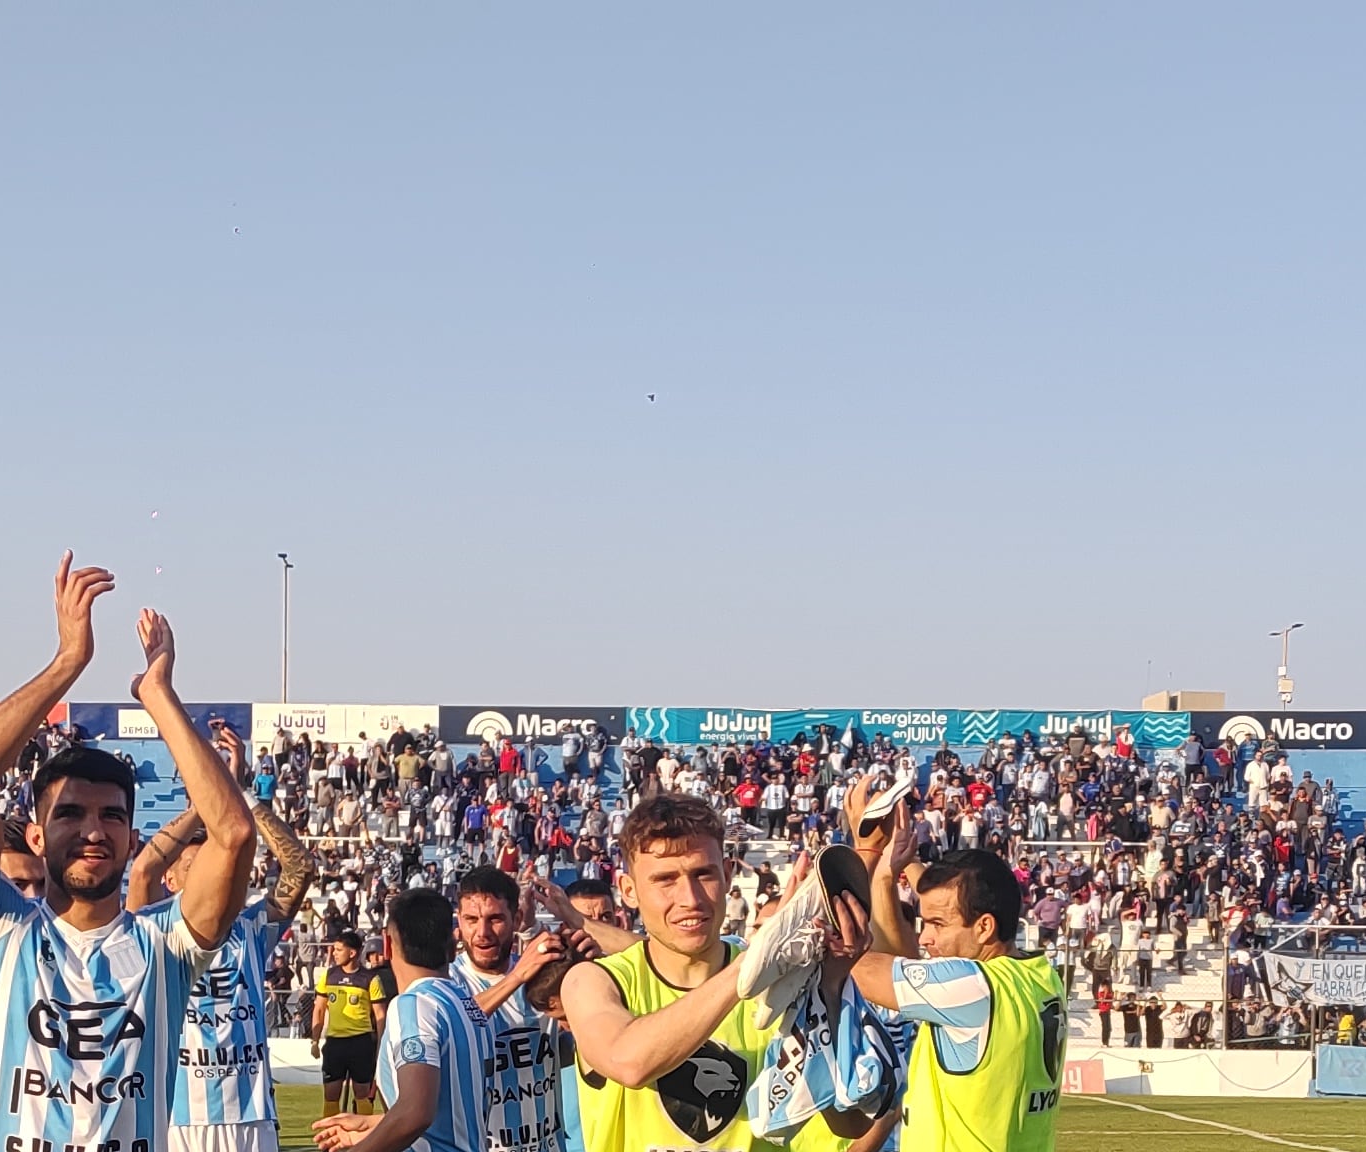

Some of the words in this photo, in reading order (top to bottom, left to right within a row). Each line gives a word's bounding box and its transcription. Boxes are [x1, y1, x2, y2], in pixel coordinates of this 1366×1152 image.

[517, 714, 597, 736] Macro
[863, 710, 948, 727] Energizate
[1271, 718, 1353, 741] Macro
[28, 998, 147, 1061] GEA
[23, 1068, 147, 1106] BANCOR
[1028, 1089, 1058, 1113] LYO
